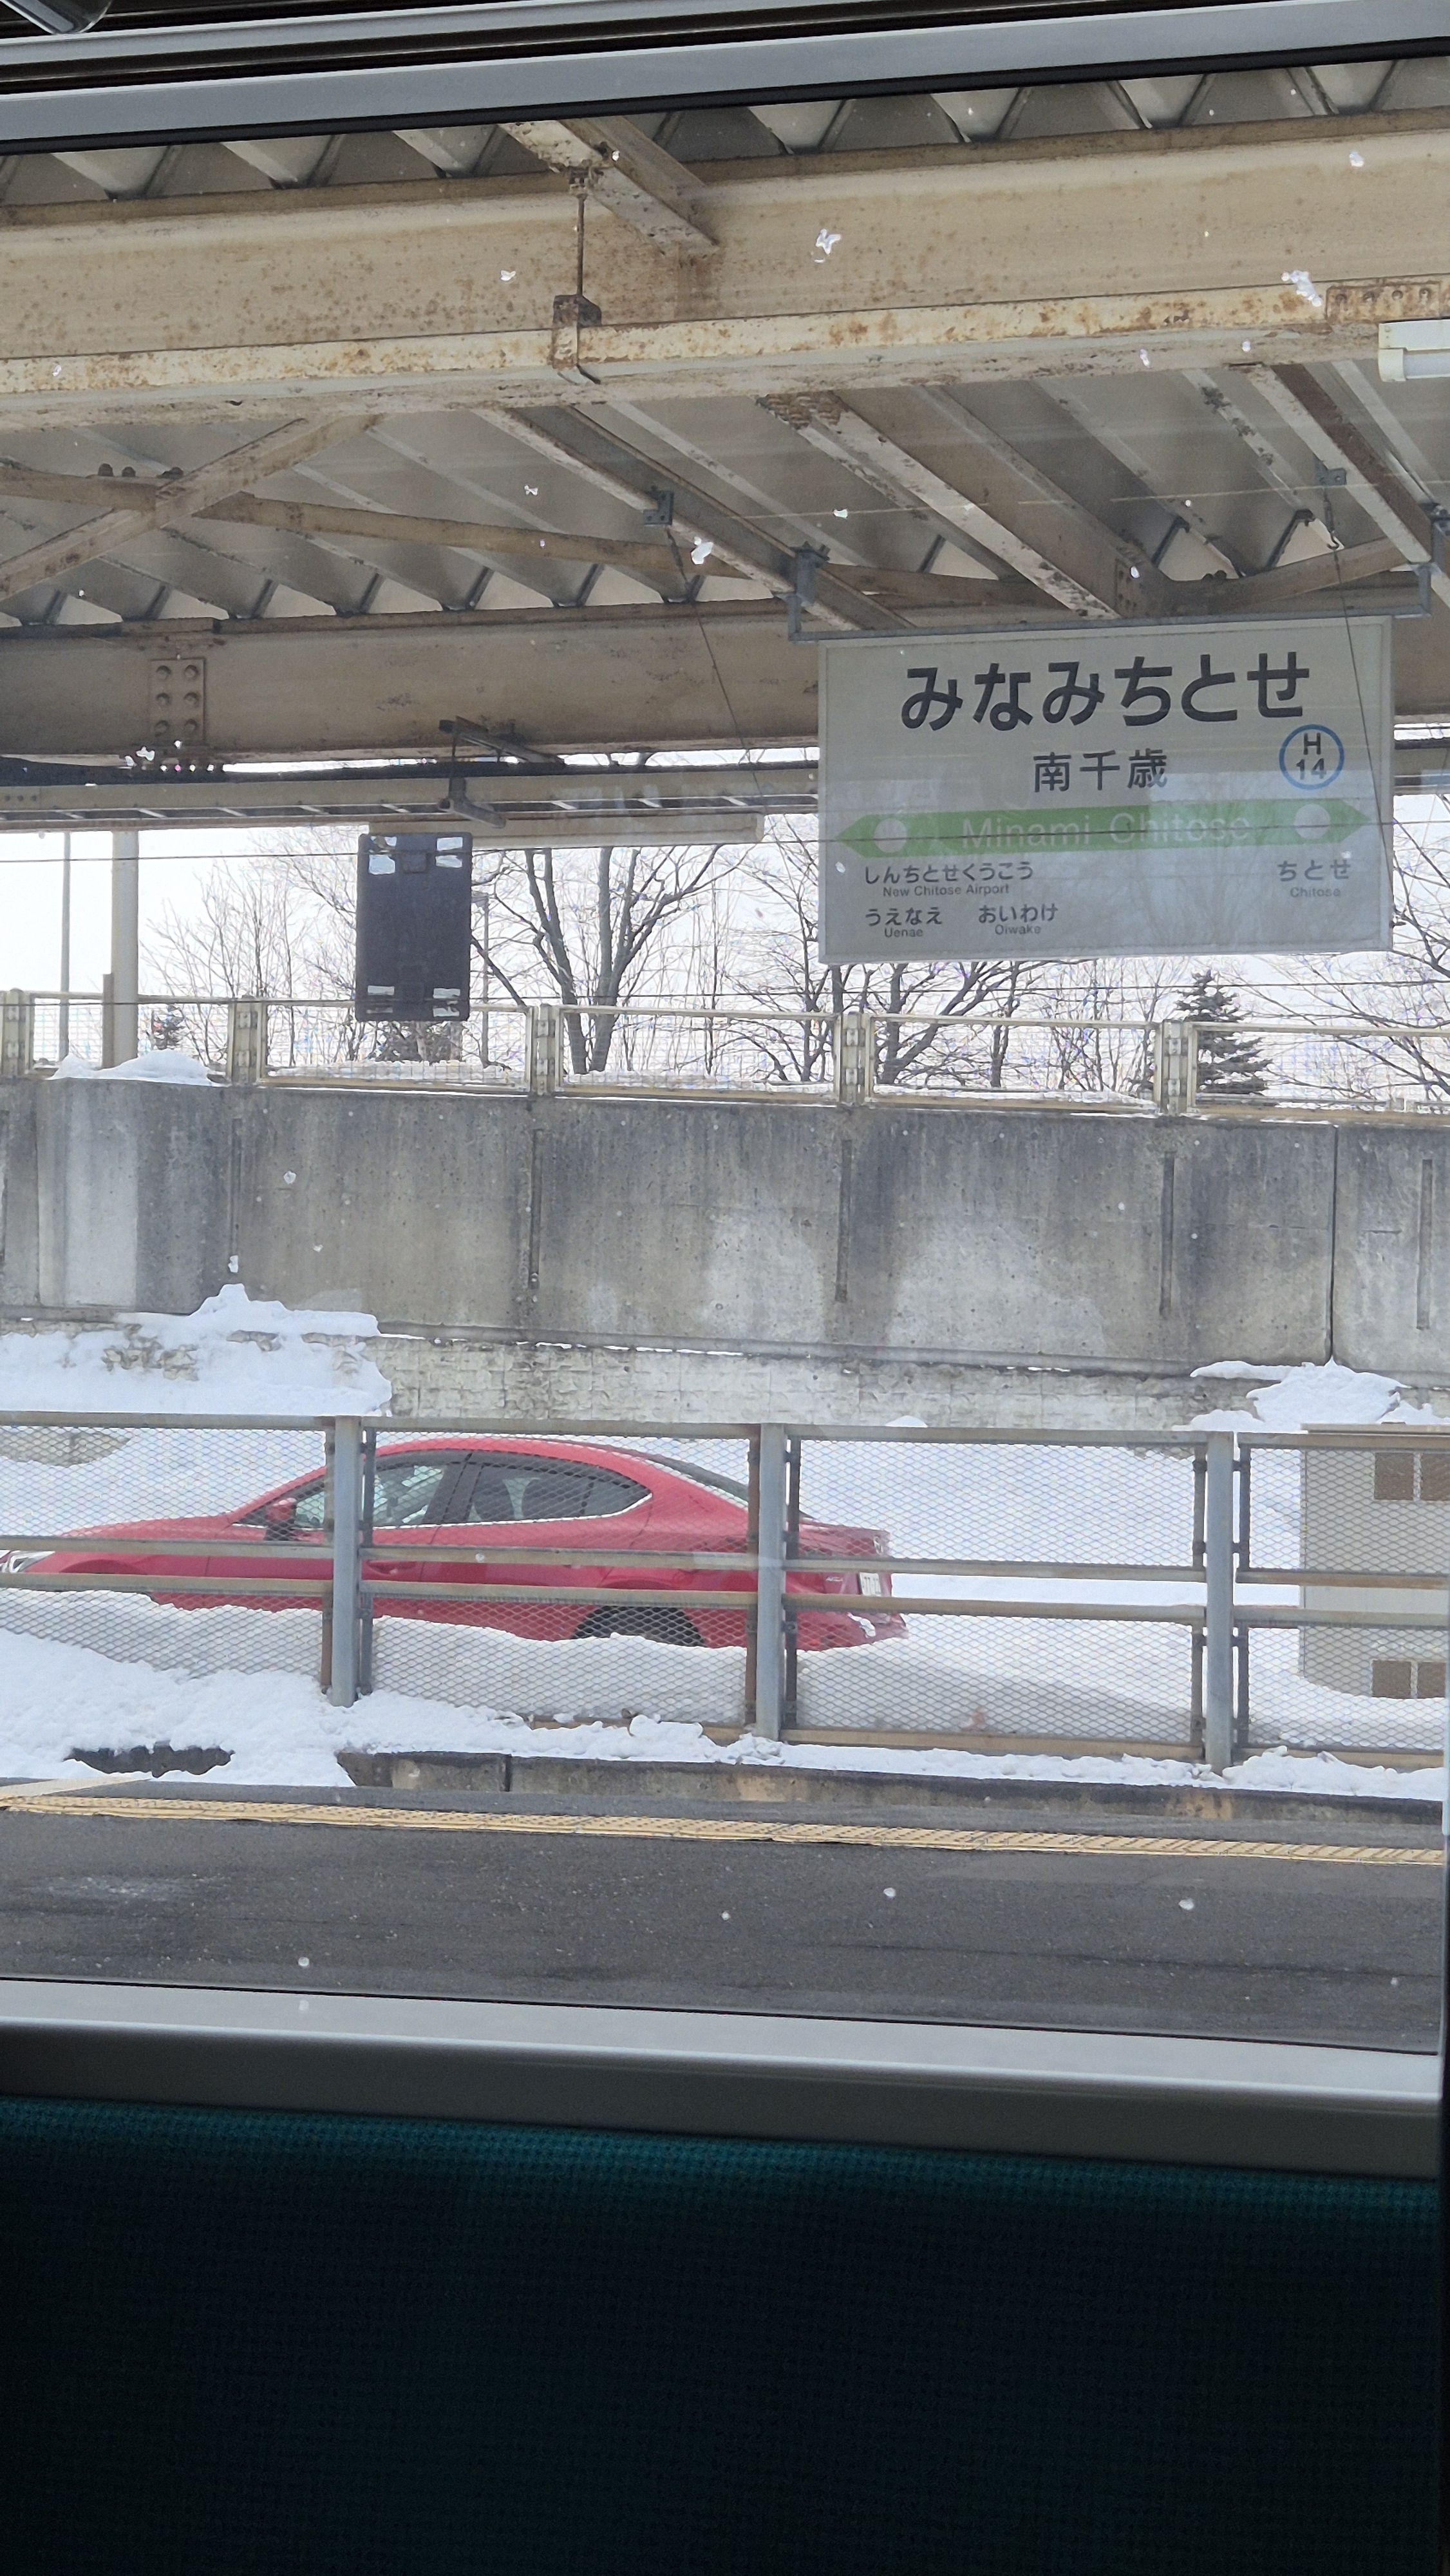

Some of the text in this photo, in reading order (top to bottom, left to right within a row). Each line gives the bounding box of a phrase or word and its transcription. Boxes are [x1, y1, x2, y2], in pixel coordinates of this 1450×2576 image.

[901, 651, 1310, 732] みなみちとせ
[1303, 732, 1321, 755] H
[1033, 748, 1168, 793] 南千歳
[1295, 757, 1327, 781] 14
[961, 811, 1251, 849] Minami Chitose
[865, 861, 1034, 885] しんちとせくうこう
[1277, 858, 1351, 882] ちとせ
[883, 883, 1010, 897] New Chitose Airport
[1289, 886, 1341, 898] Chitose
[865, 906, 943, 926] うえなえ
[977, 902, 1059, 924] おいわけ
[883, 927, 923, 938] Uenae
[994, 923, 1042, 936] Oiwake
